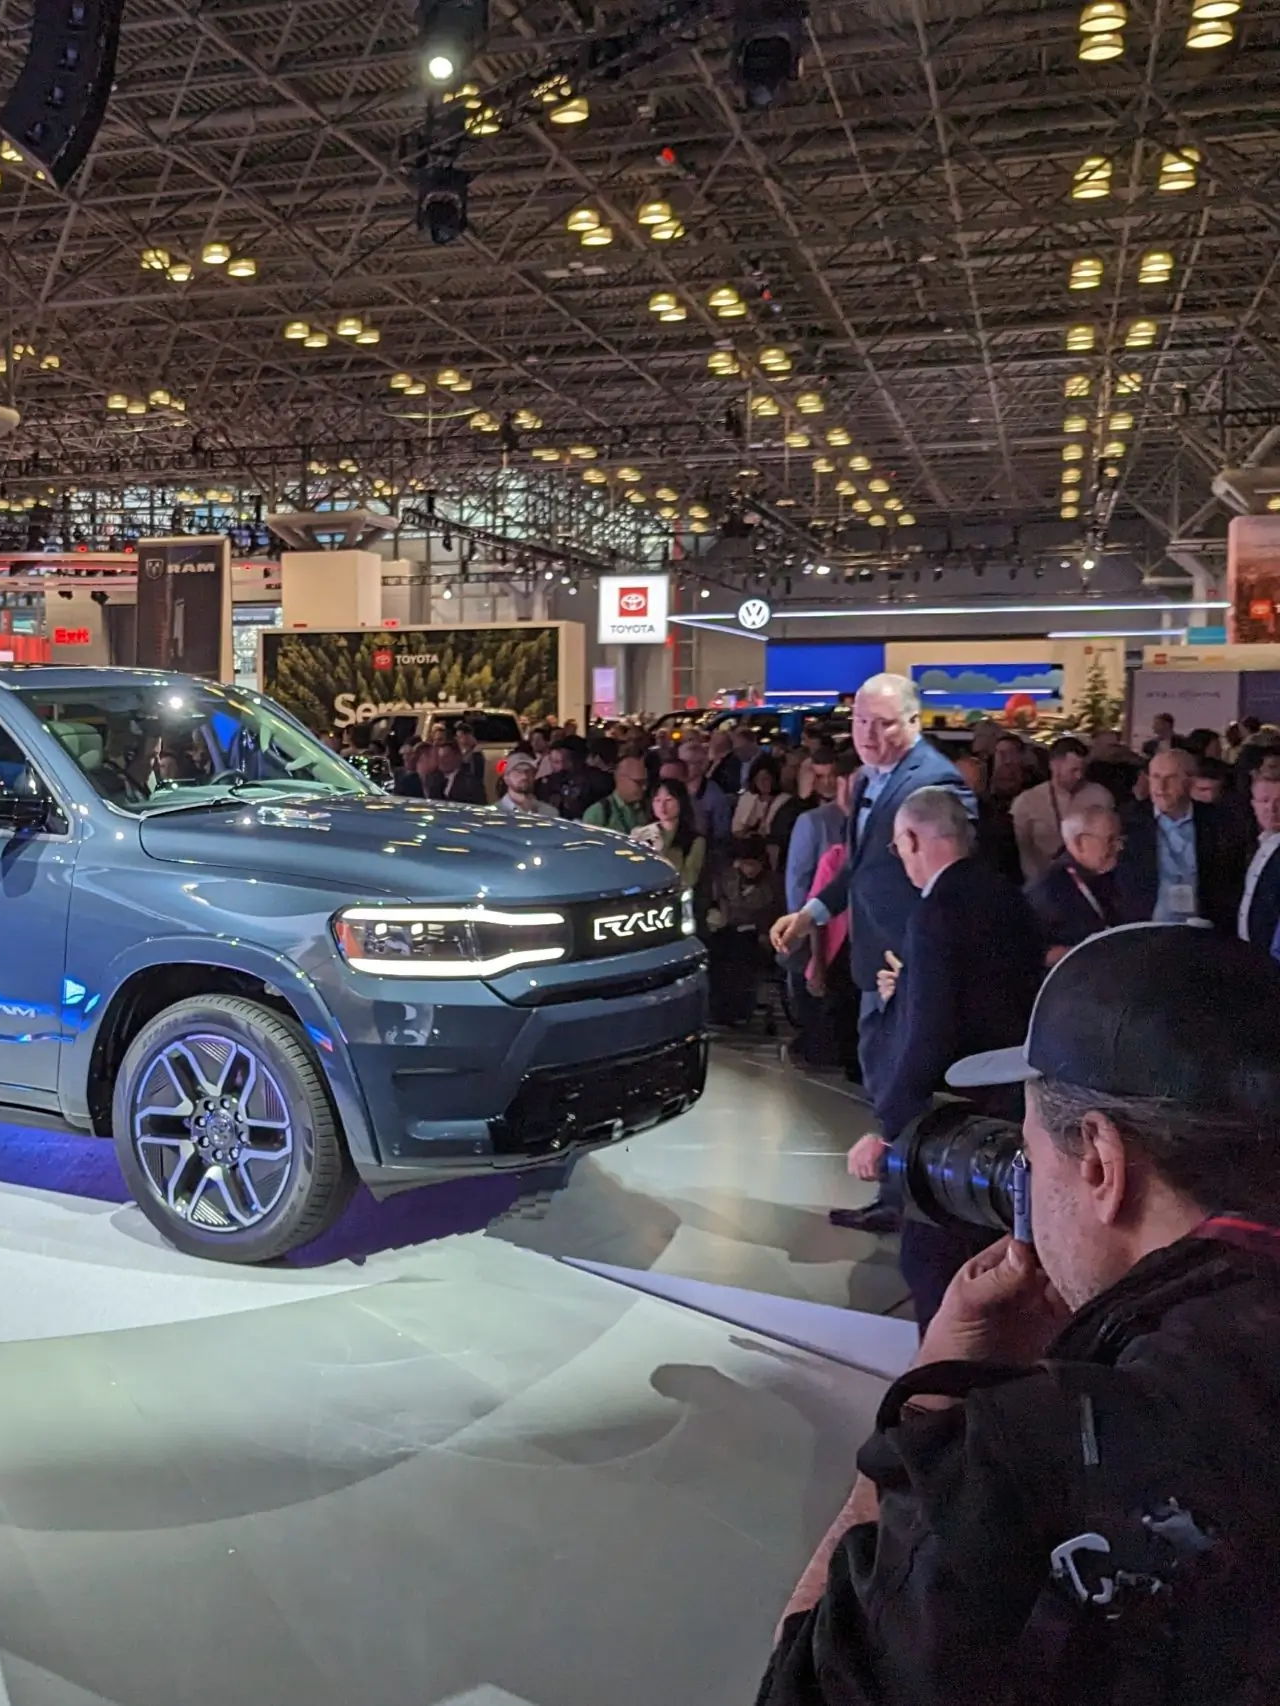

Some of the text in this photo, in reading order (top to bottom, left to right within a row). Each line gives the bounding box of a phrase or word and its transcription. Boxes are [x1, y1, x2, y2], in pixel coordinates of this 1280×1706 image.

[167, 562, 215, 574] RAM
[610, 624, 656, 634] TOYOTA
[395, 654, 440, 665] TOYOTA
[593, 906, 674, 941] RAM
